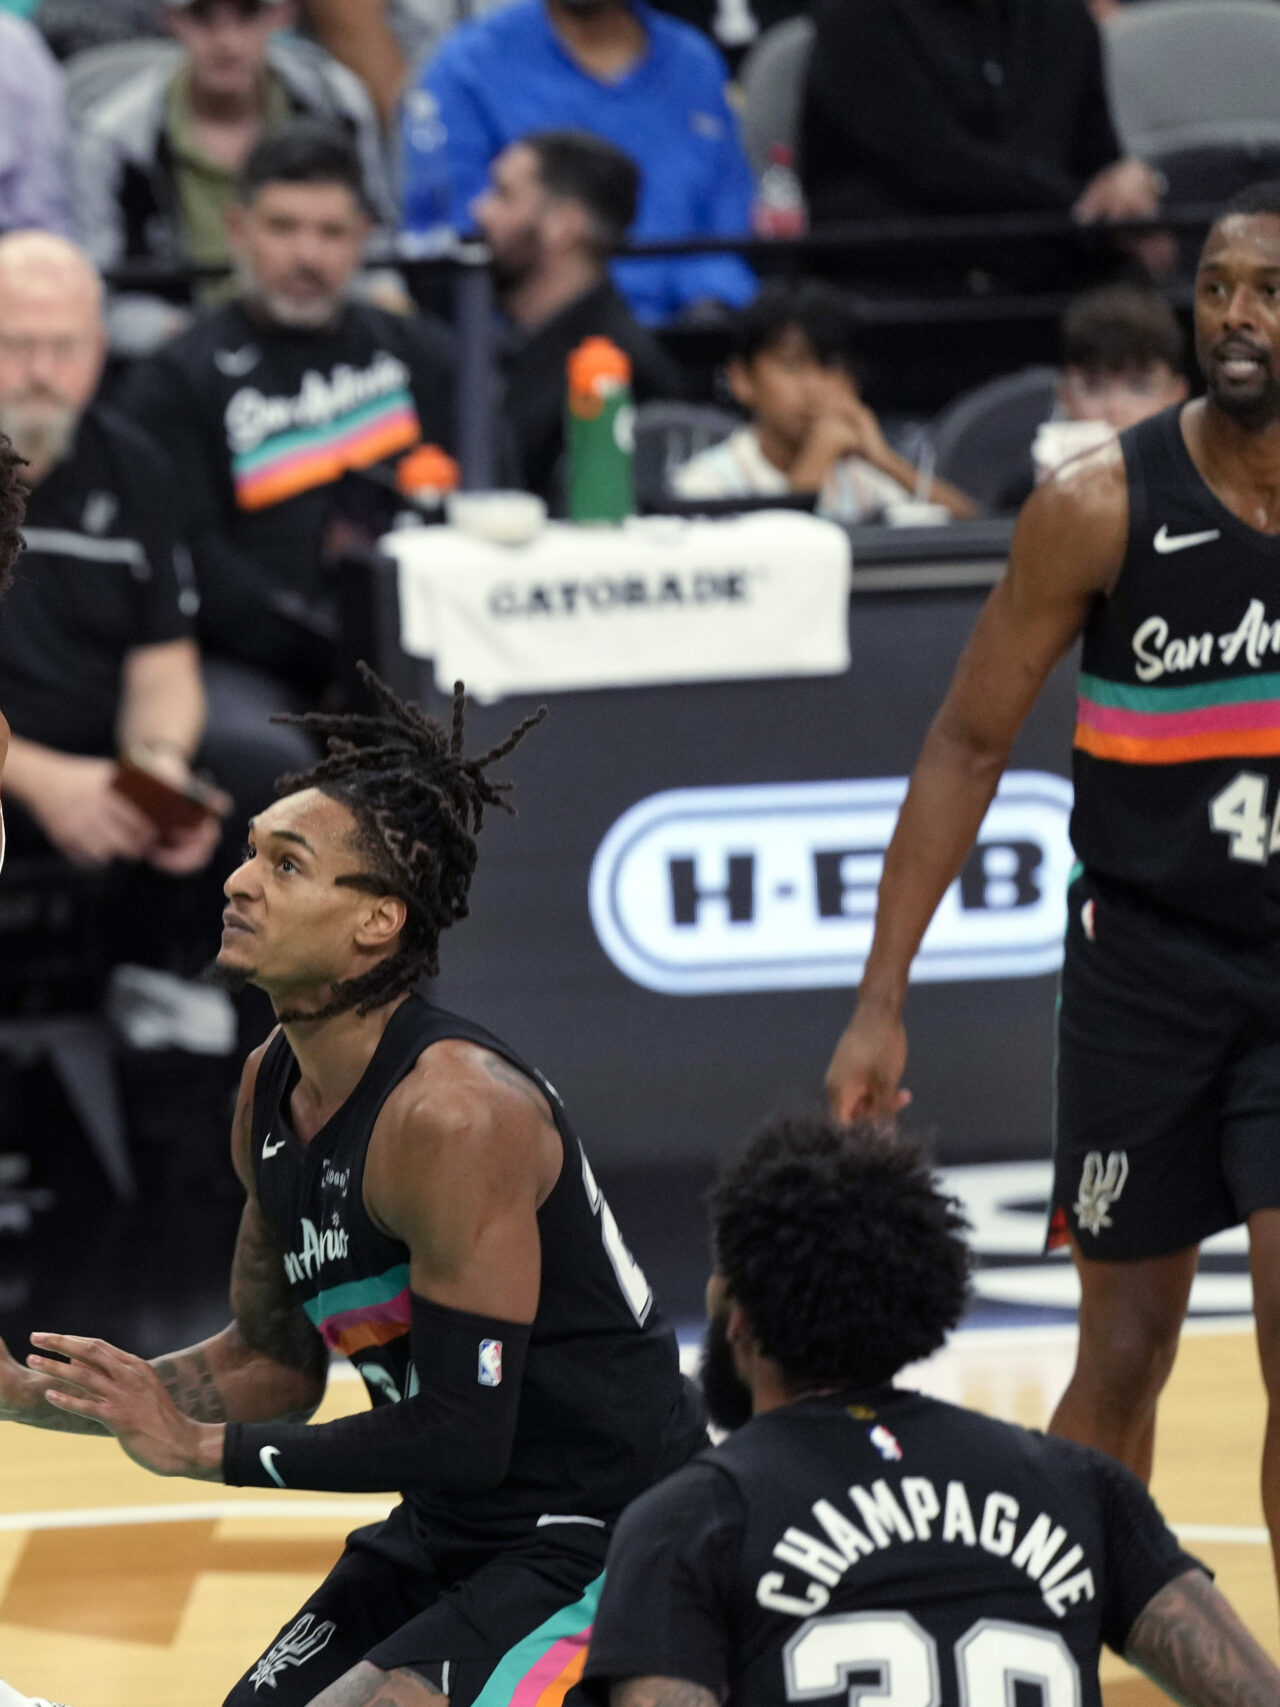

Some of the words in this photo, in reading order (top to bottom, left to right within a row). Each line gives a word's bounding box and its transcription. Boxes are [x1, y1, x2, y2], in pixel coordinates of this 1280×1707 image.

[488, 567, 749, 620] GATORADE
[1132, 615, 1215, 682] San
[756, 1476, 1095, 1618] CHAMPAGNIE
